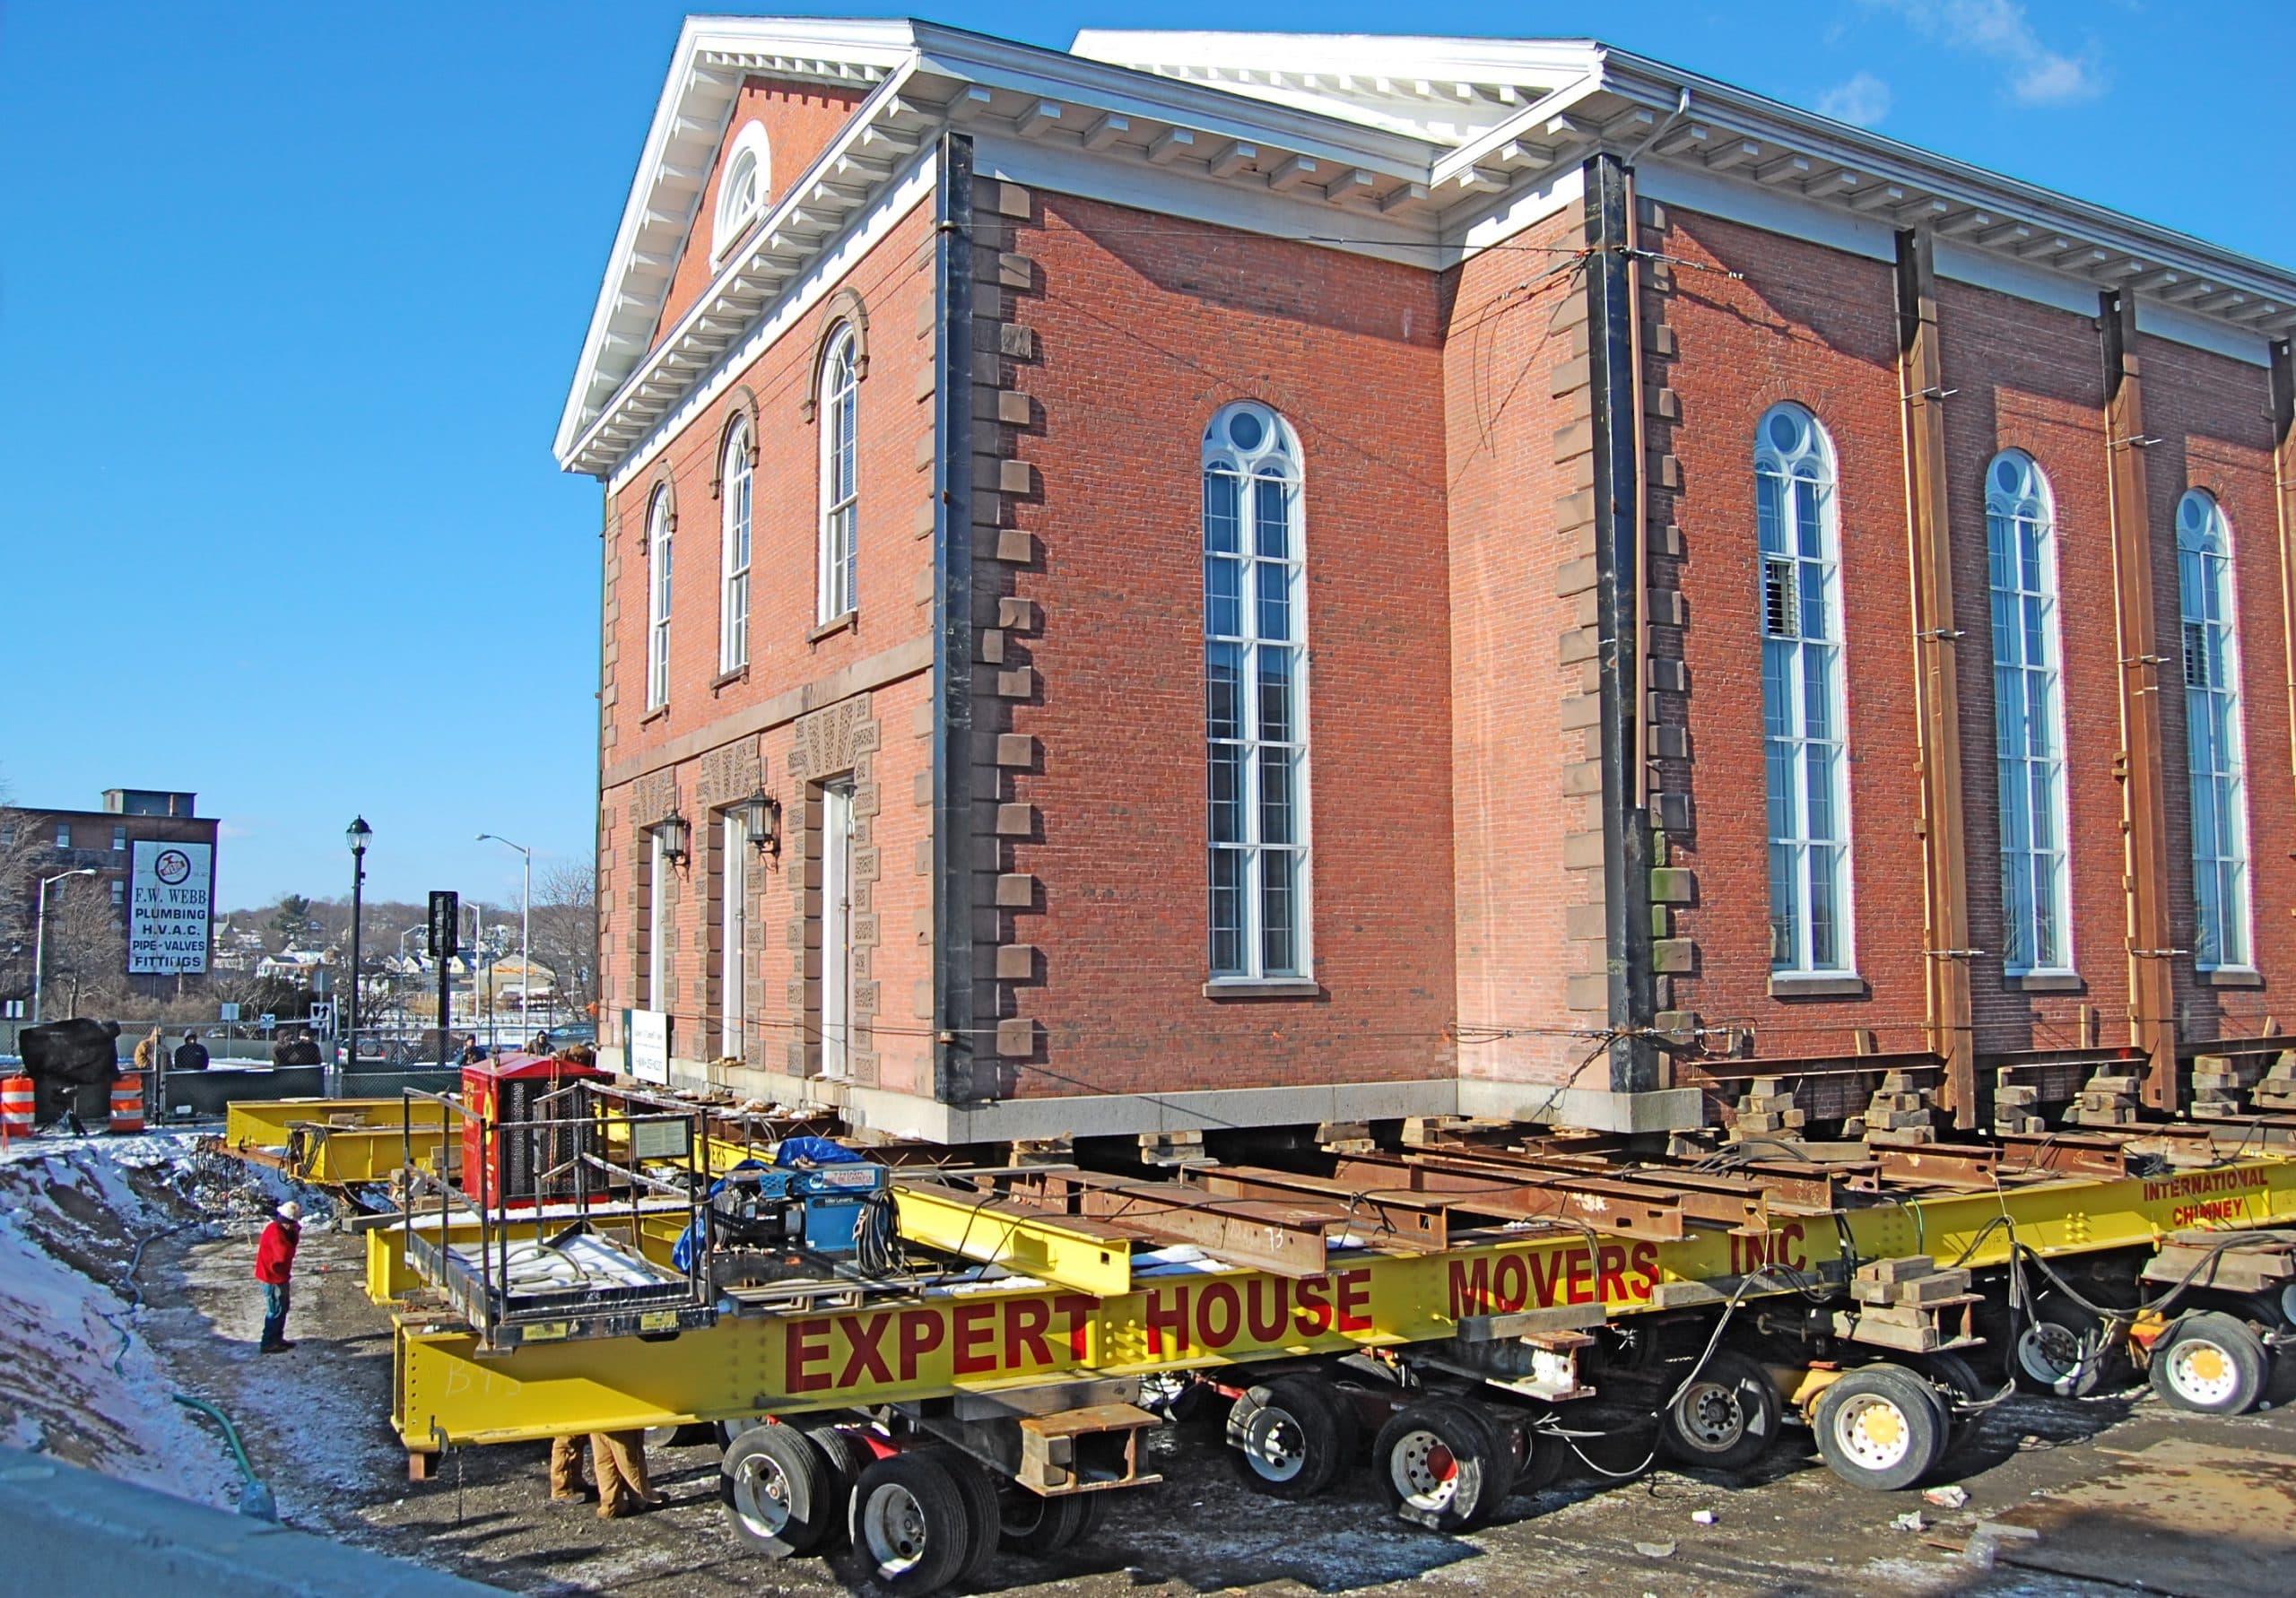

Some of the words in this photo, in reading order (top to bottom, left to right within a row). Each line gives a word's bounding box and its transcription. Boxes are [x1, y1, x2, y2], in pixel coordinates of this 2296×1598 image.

[135, 888, 163, 903] F.W.
[170, 889, 206, 905] WEBB
[135, 908, 205, 920] PLUMBING
[143, 925, 200, 935] H.V.A.C.
[135, 956, 201, 967] FITTINGS
[2144, 1168, 2268, 1202] INTERNATIONAL
[2172, 1198, 2243, 1226] CHIMNEY
[786, 1295, 1100, 1394] EXPERT
[1146, 1268, 1373, 1354] HOUSE
[1448, 1241, 1660, 1321] MOVERS
[1730, 1223, 1806, 1276] INC
